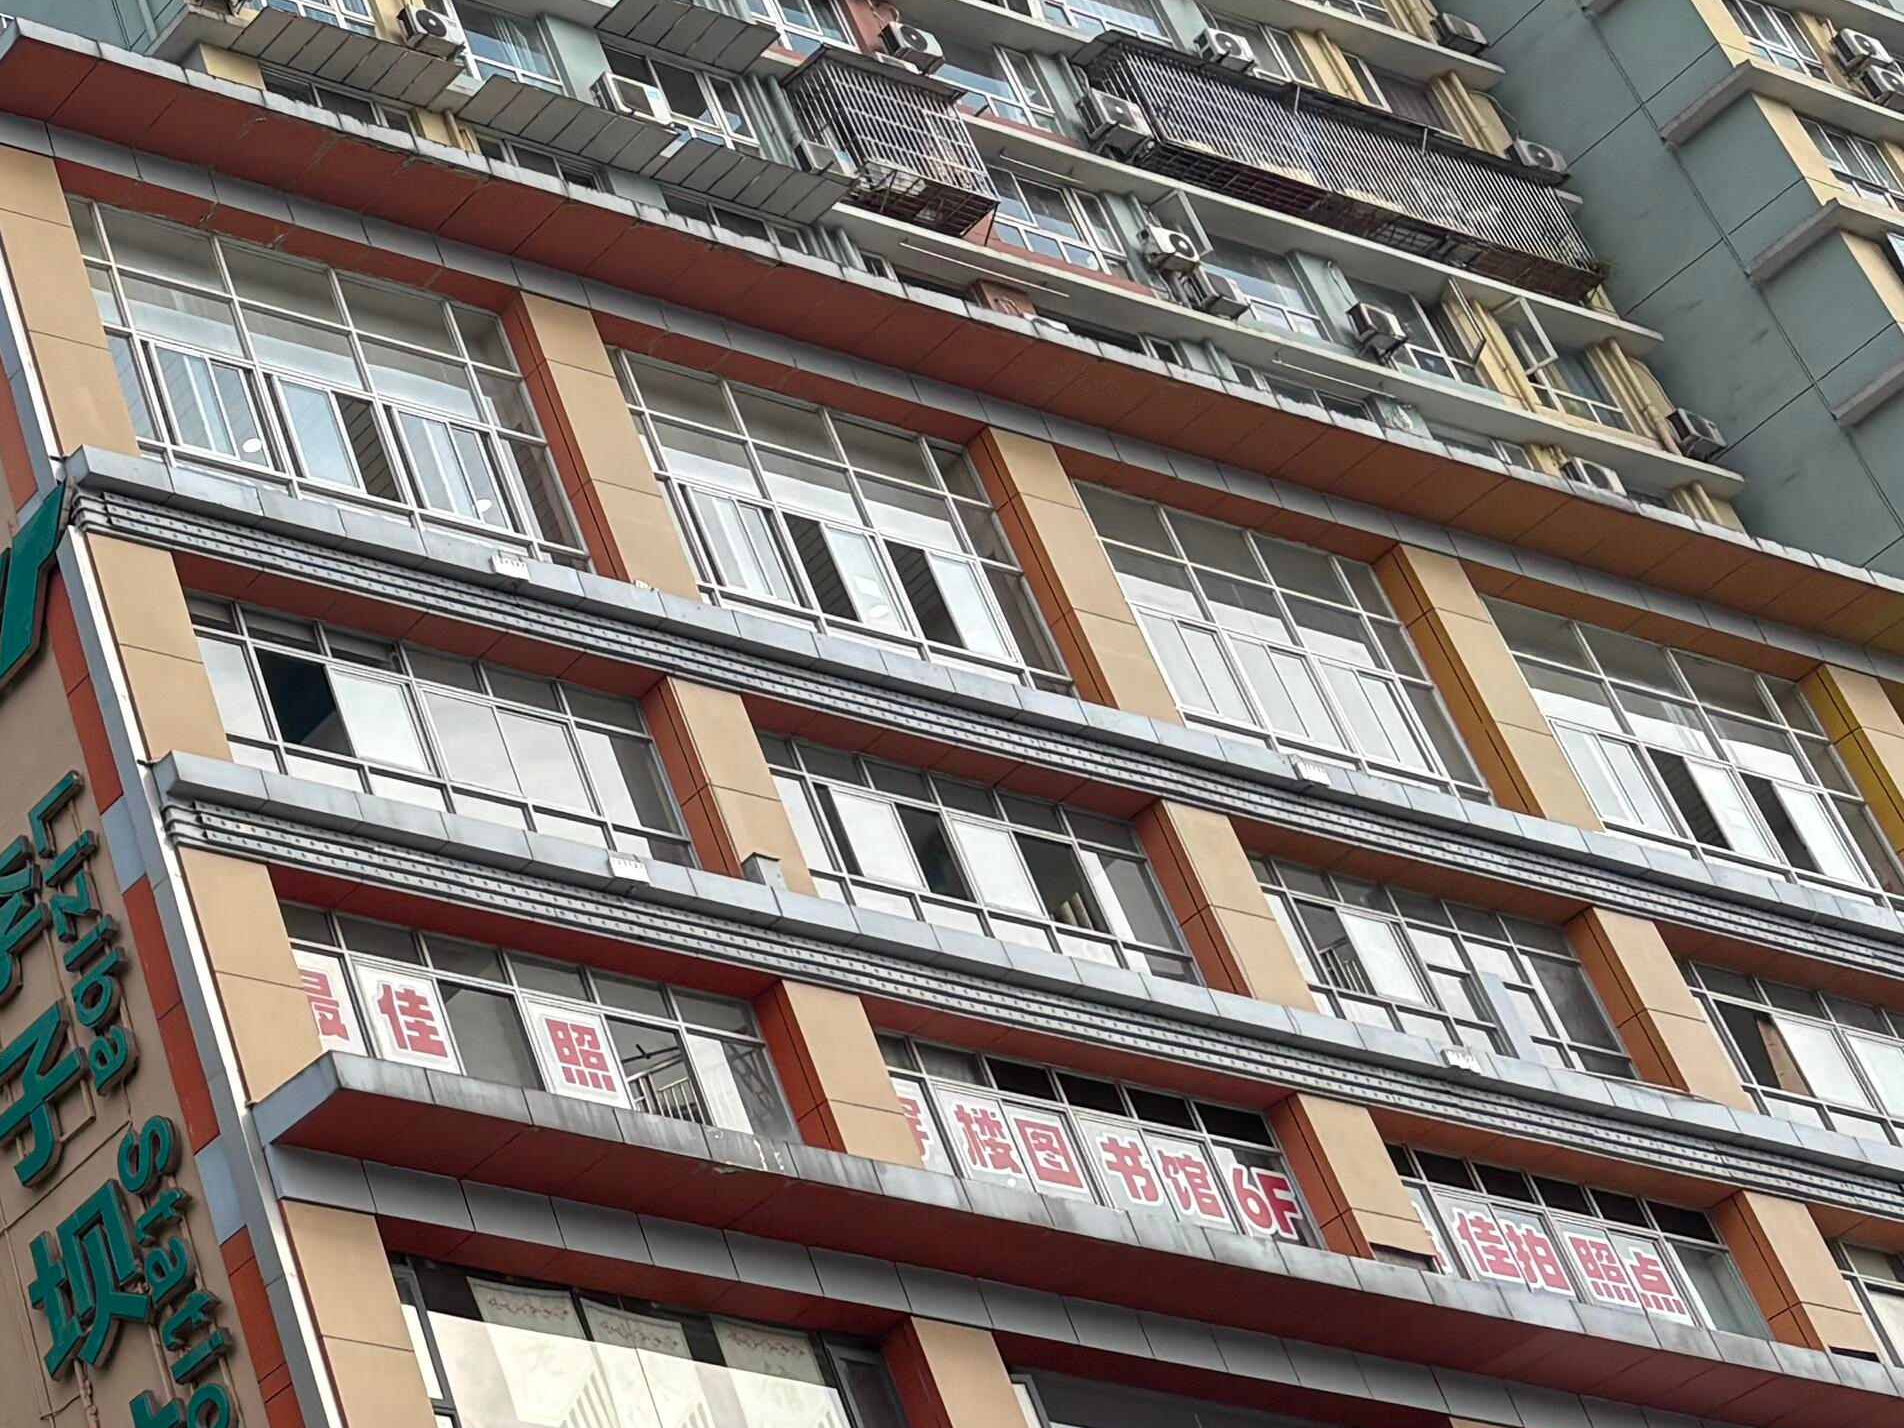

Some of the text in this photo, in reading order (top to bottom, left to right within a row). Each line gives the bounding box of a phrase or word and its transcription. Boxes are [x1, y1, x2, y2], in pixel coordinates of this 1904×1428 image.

[28, 769, 140, 1096] Liziba
[1434, 1208, 1688, 1316] 佳拍照点
